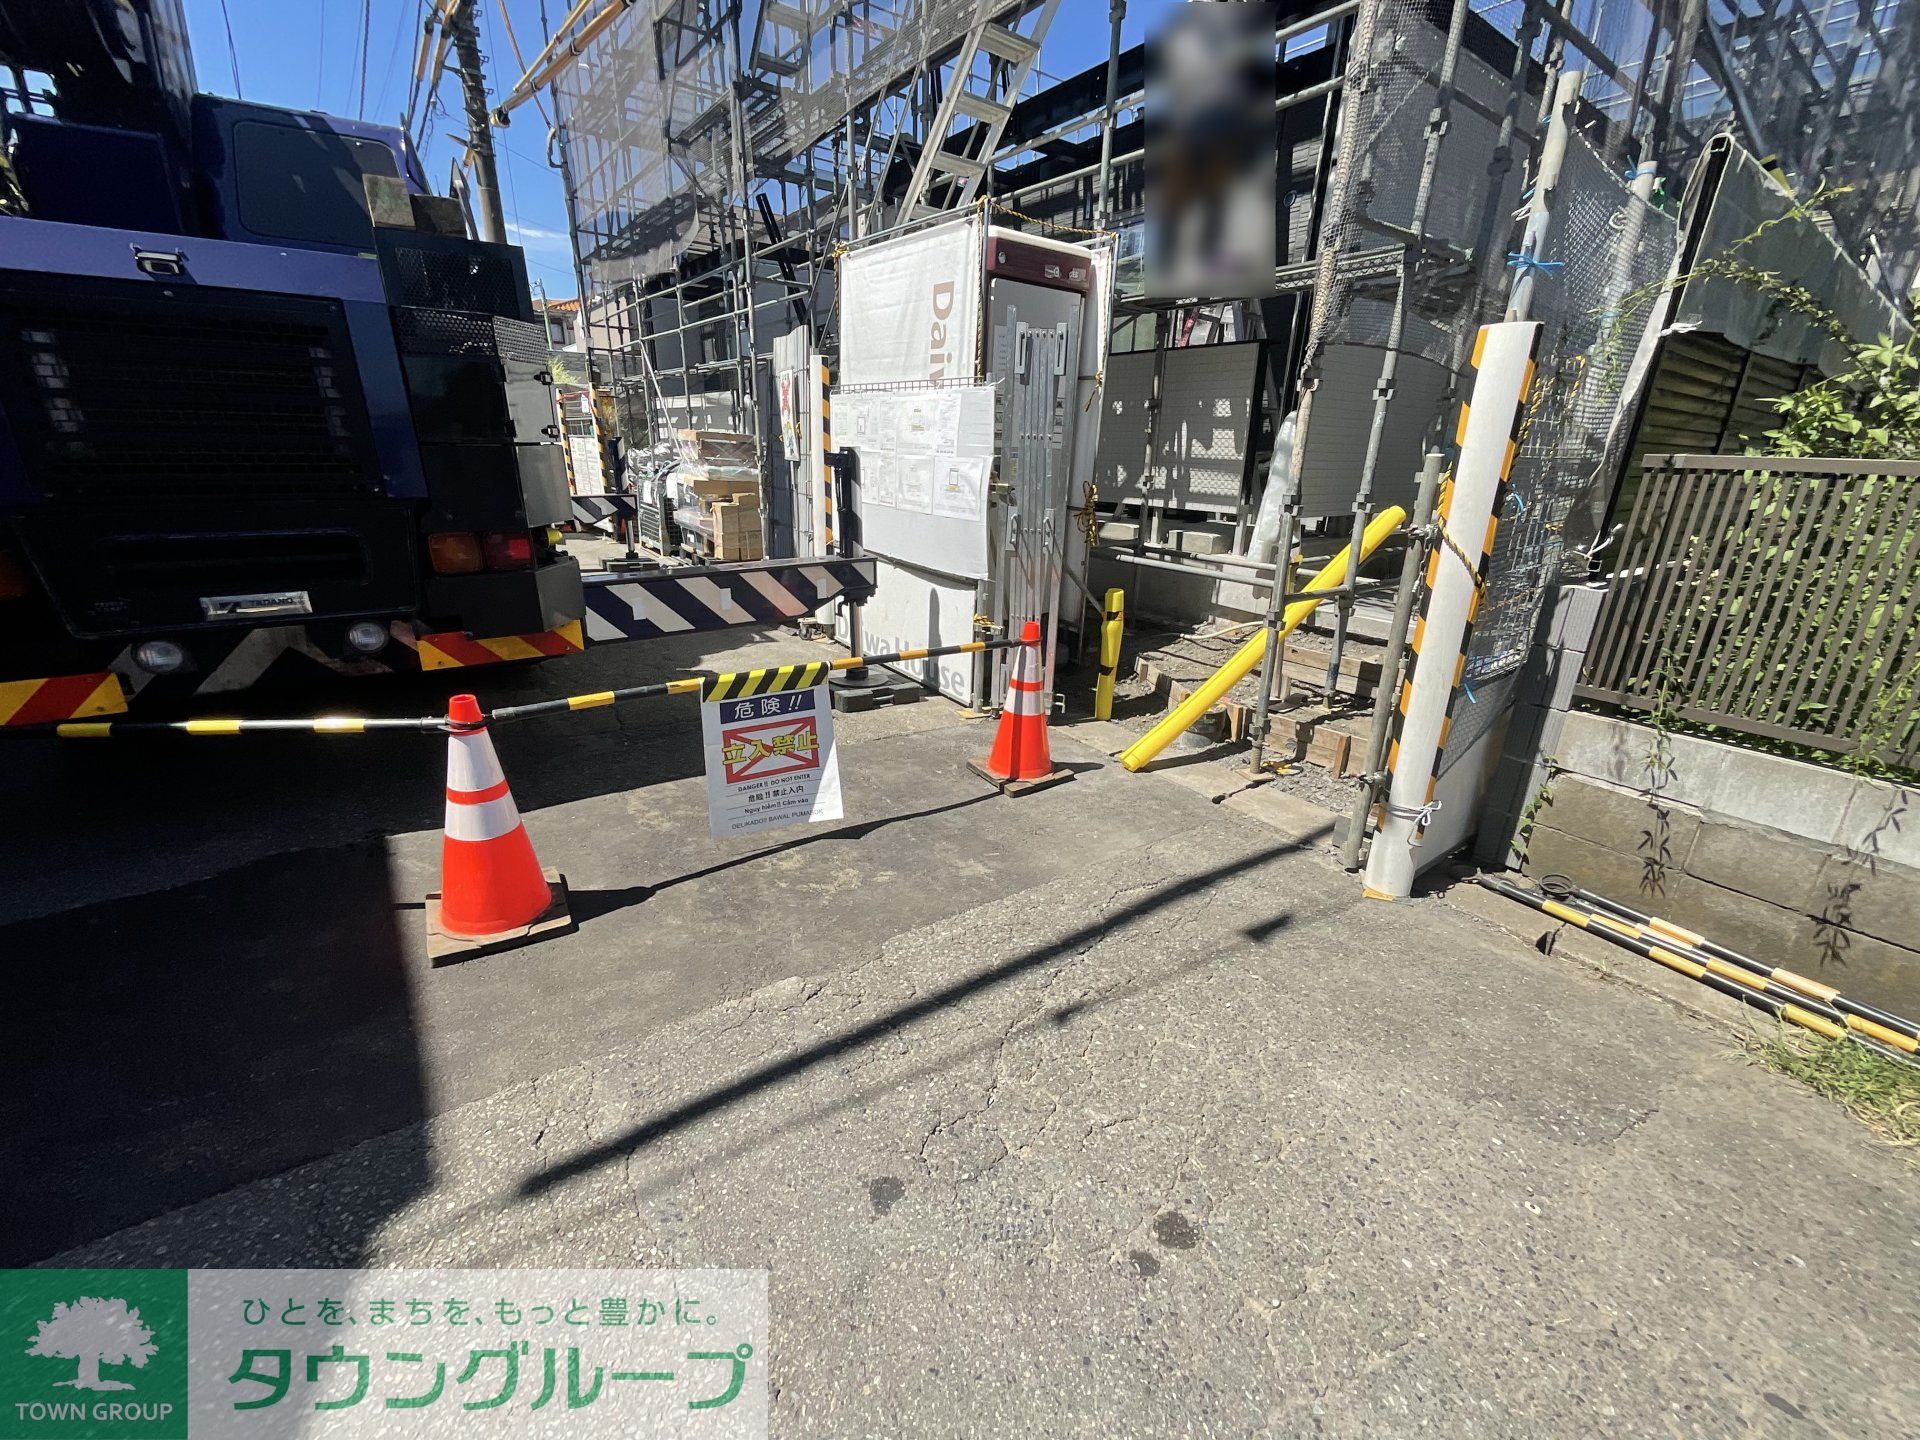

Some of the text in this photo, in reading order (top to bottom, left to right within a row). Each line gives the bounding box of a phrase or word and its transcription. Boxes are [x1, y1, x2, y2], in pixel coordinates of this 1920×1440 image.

[721, 730, 820, 765] 立入禁止
[770, 777, 780, 786] DO
[780, 775, 793, 784] NOT
[793, 773, 811, 781] ENTER
[768, 813, 791, 823] BAWAL
